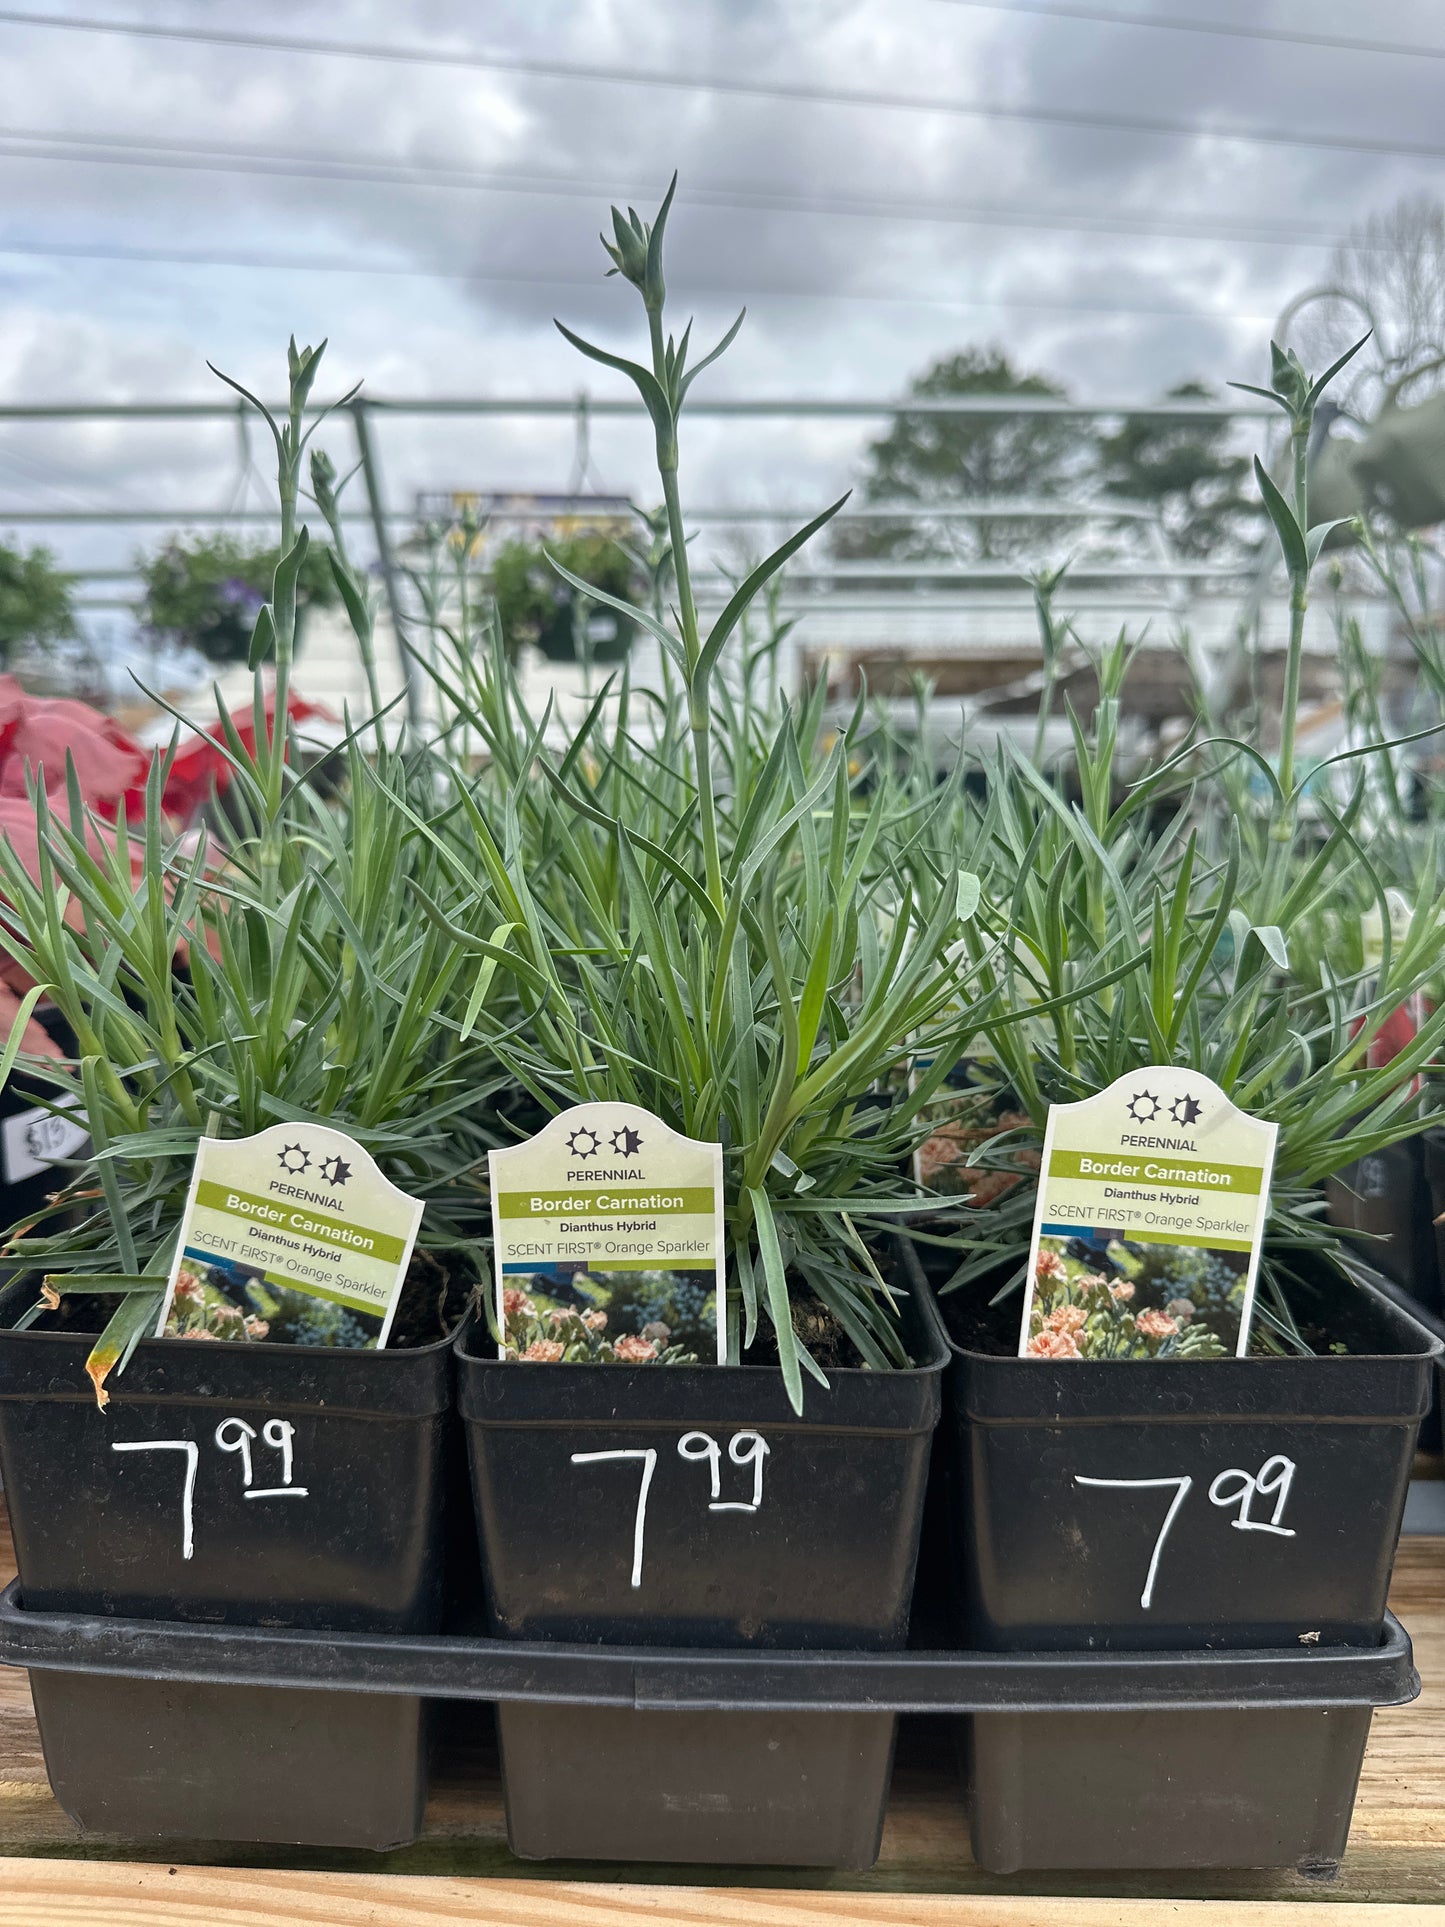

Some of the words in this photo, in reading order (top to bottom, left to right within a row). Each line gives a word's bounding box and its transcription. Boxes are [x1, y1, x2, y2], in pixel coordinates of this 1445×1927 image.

[1120, 1134, 1197, 1152] PERENNIAL
[567, 1169, 646, 1182] PERENNIAL
[1079, 1158, 1140, 1177] Border
[1144, 1164, 1231, 1186] Carnation
[269, 1180, 345, 1212] PERENNIAL
[530, 1196, 591, 1212] Border
[596, 1194, 684, 1211] Carnation
[1103, 1187, 1156, 1202] Dianthus
[1159, 1191, 1199, 1206] Hybrid
[226, 1193, 287, 1223] Border
[290, 1214, 375, 1250] Carnation
[559, 1221, 614, 1233] Dianthus
[616, 1220, 657, 1234] Hybrid
[1049, 1204, 1094, 1219] SCENT
[1144, 1212, 1192, 1229] Orange
[1196, 1216, 1250, 1233] Sparkler
[248, 1226, 301, 1250] Dianthus
[303, 1243, 342, 1263] Hybrid
[507, 1243, 552, 1256] SCENT
[605, 1241, 654, 1256] Orange
[657, 1240, 710, 1254] Sparkler
[193, 1230, 238, 1252] SCENT
[286, 1259, 332, 1283] Orange
[336, 1273, 387, 1299] Sparkler
